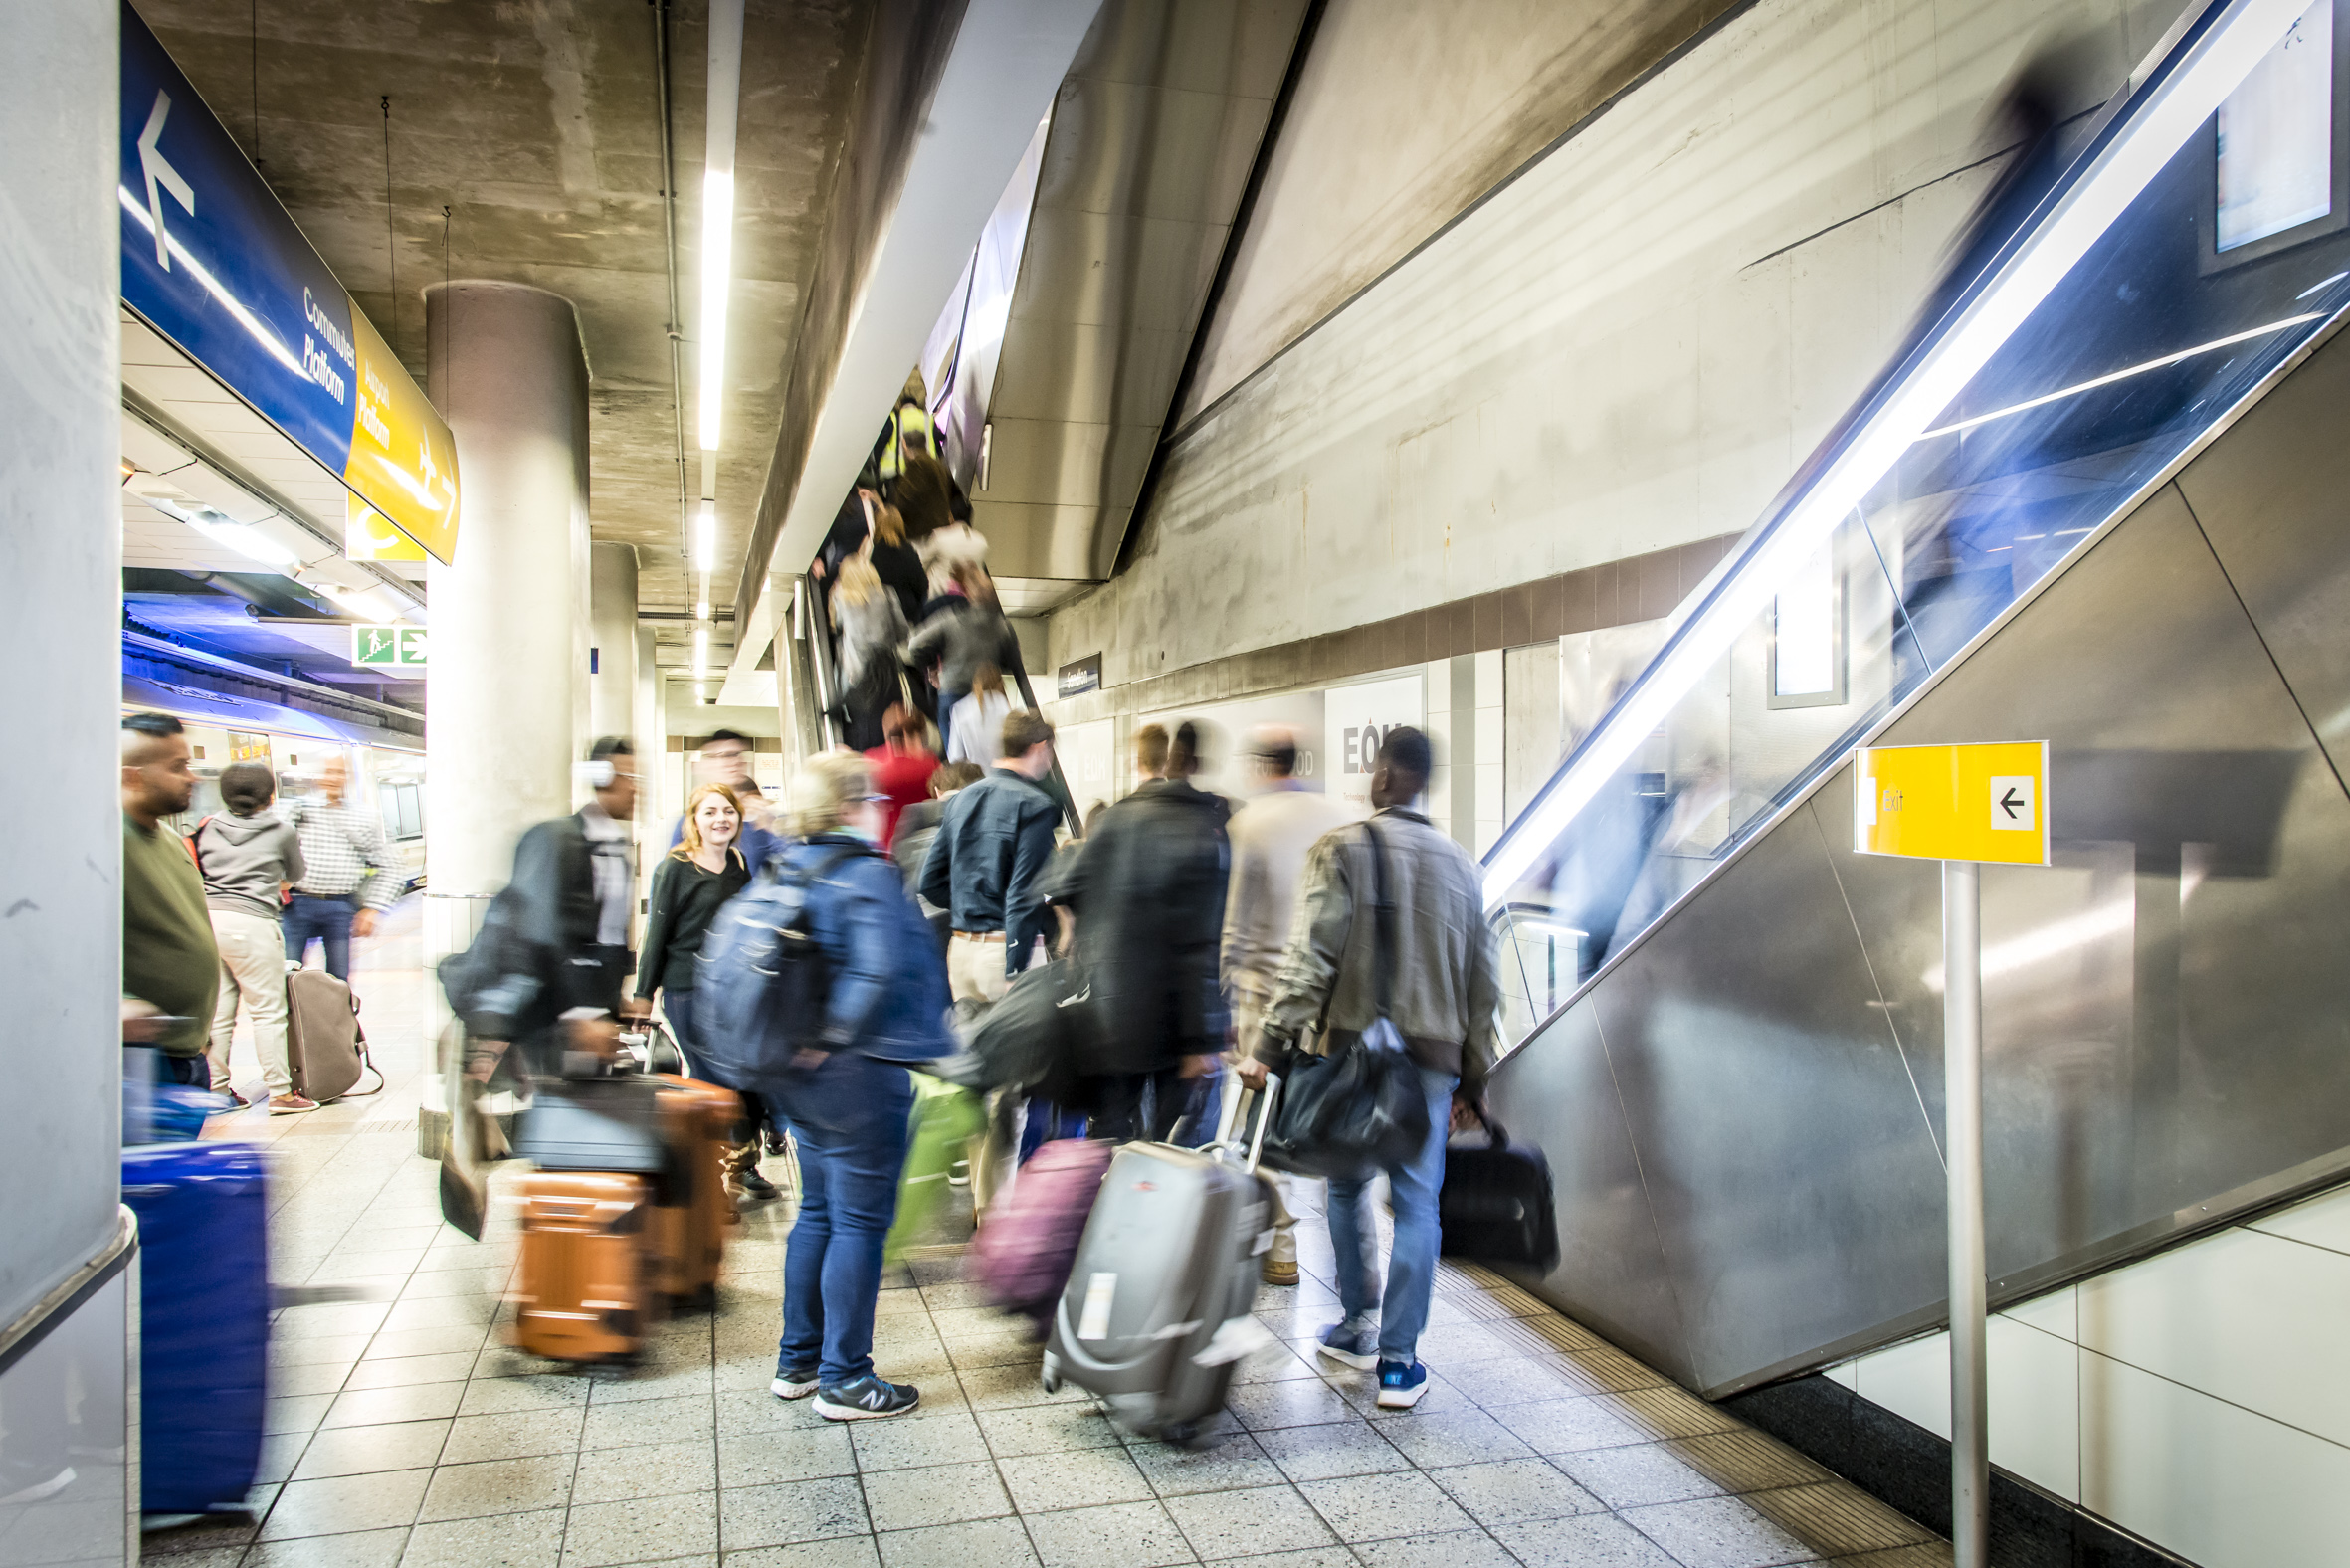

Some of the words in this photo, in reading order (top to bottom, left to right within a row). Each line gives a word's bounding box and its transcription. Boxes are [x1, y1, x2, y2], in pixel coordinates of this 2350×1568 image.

[303, 286, 355, 371] Commuter
[303, 333, 345, 405] Platform
[365, 358, 390, 410] Airport
[358, 392, 390, 450] Platform
[1343, 791, 1366, 804] Technology
[1883, 789, 1904, 811] Exit
